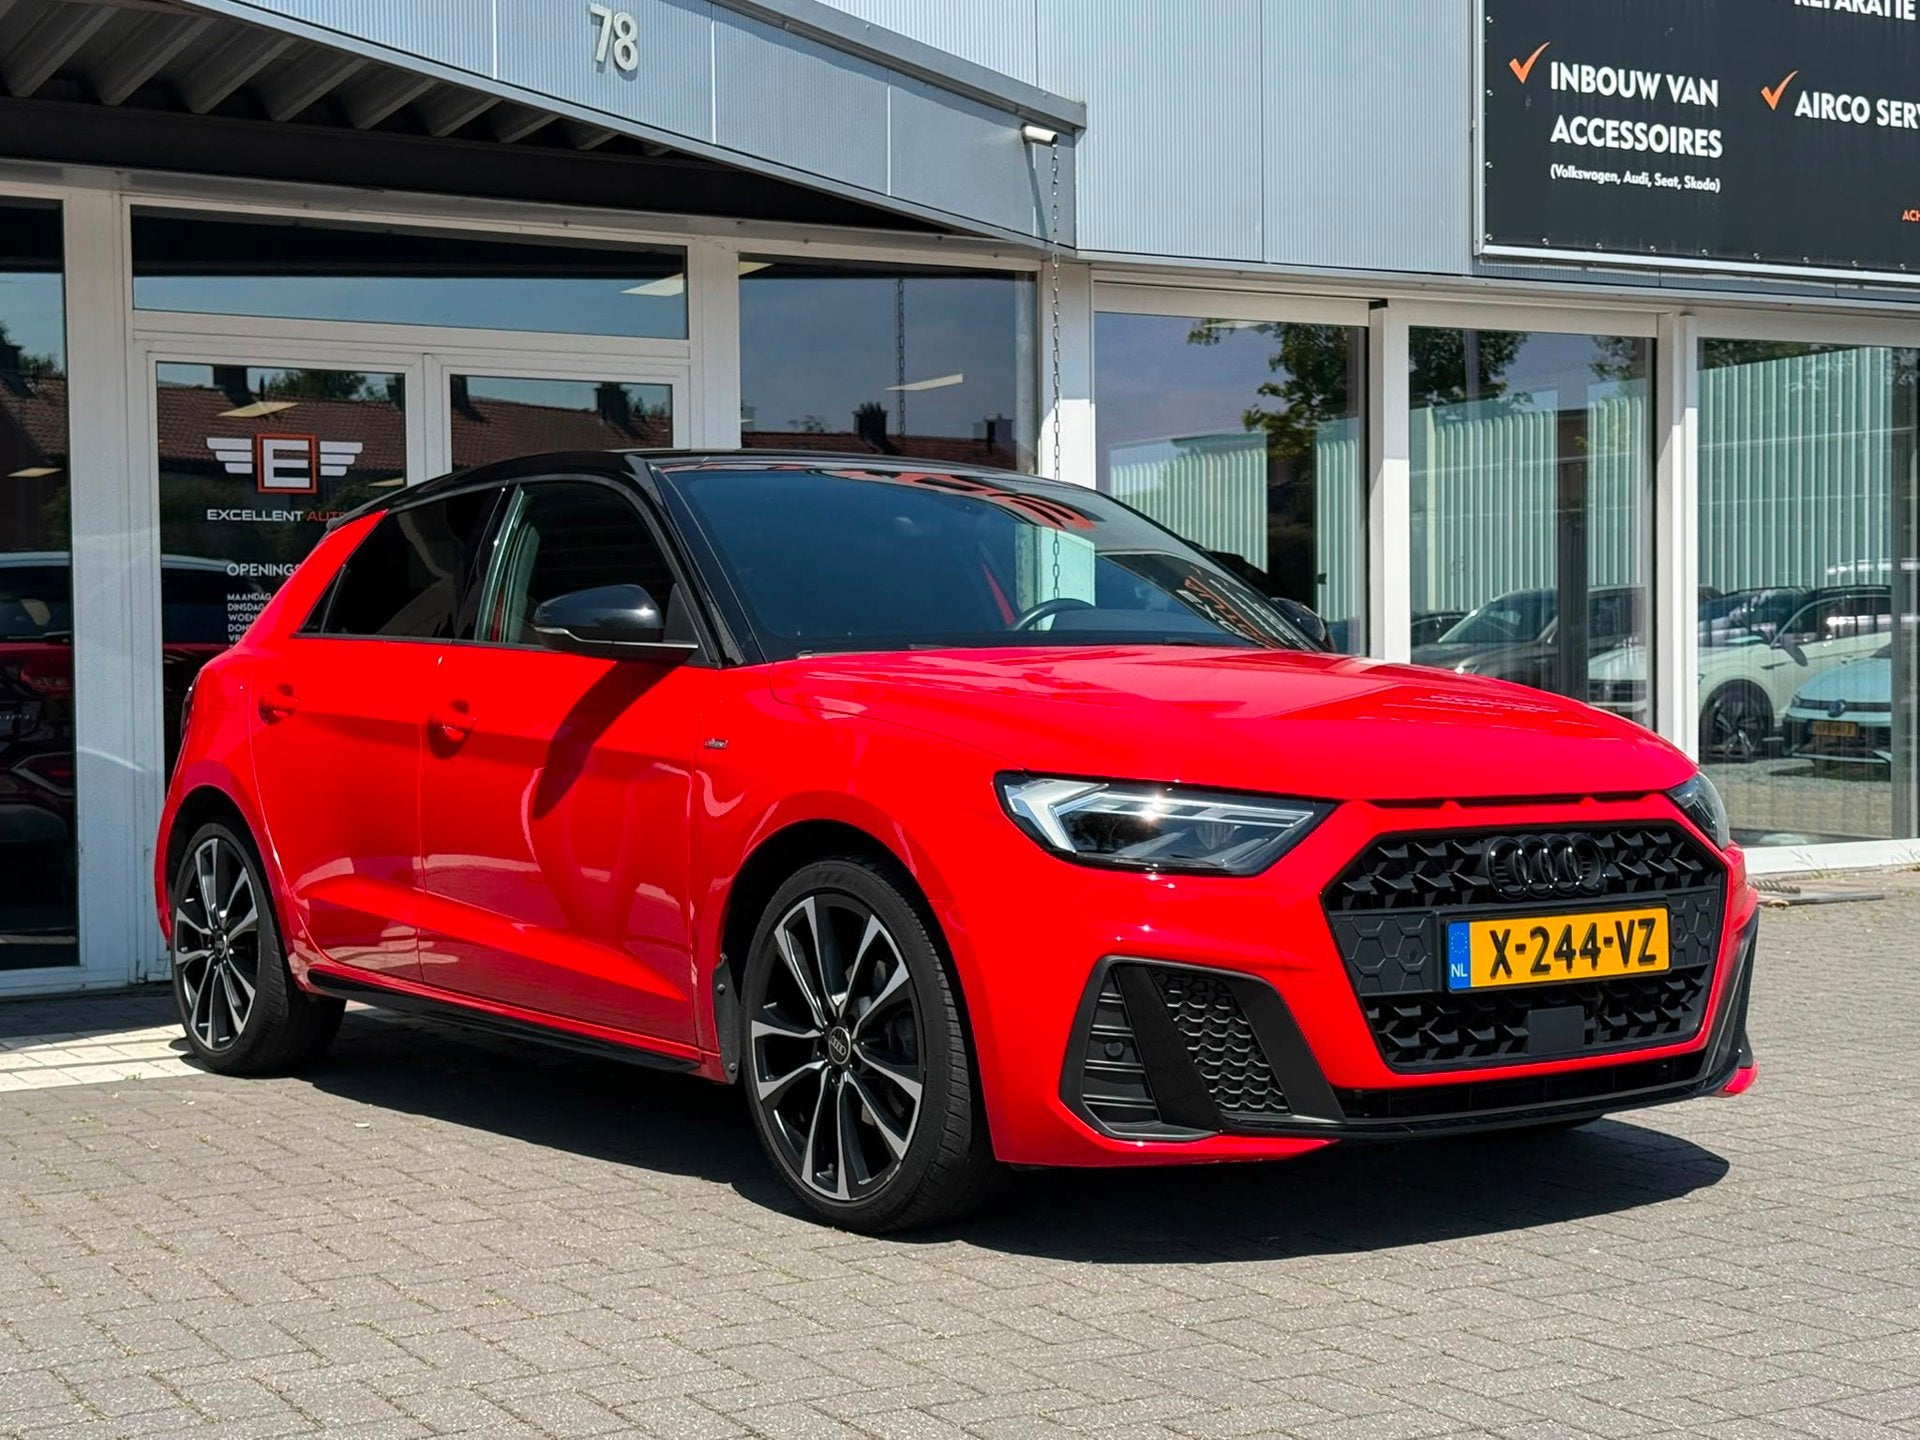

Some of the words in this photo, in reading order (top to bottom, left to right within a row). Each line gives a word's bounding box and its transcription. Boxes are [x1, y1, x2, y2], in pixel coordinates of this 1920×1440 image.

[1794, 0, 1916, 21] RATIE
[590, 4, 638, 71] 78
[1550, 61, 1662, 101] INBOUW
[1665, 74, 1719, 108] VAN
[1794, 90, 1871, 124] AIRCO
[1550, 114, 1723, 158] ACCESSOIRES
[1550, 163, 1621, 185] (Volkswagen,
[1622, 170, 1652, 188] Audi,
[1654, 173, 1682, 190] Seat,
[1684, 175, 1721, 194] Skoda)
[206, 509, 304, 522] EXCELLENT
[227, 592, 272, 601] MAANDAG
[1489, 918, 1657, 980] X-244-VZ
[1451, 964, 1468, 978] NL
